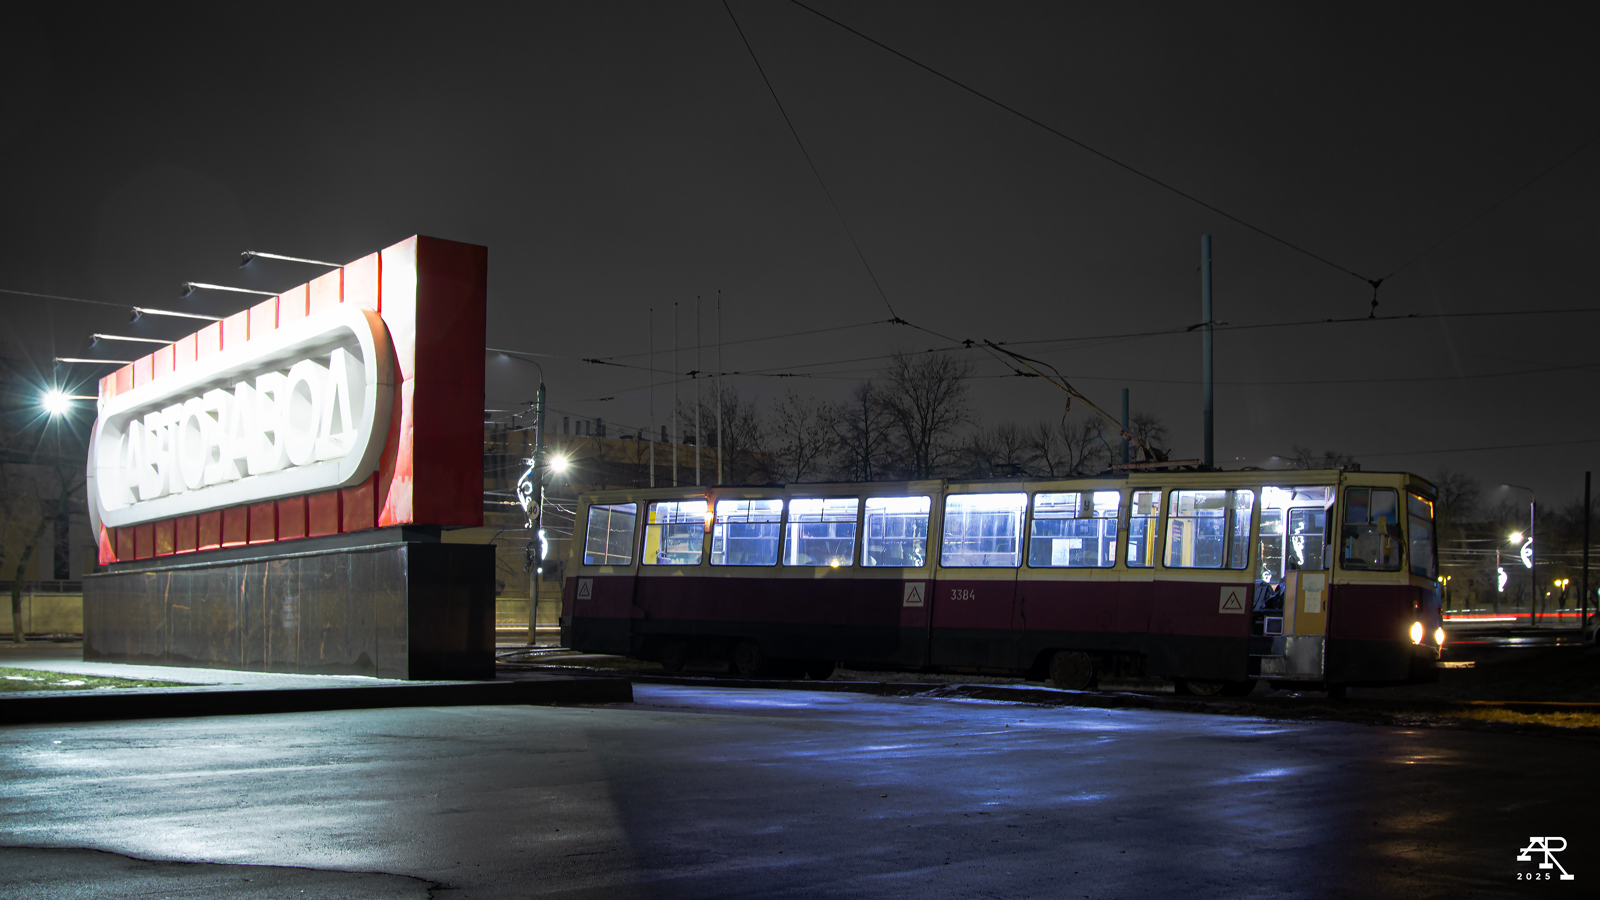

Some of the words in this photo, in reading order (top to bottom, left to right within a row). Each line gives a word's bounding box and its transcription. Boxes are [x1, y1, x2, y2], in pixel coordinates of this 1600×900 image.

[124, 347, 360, 504] АВТОЗАВОД
[528, 506, 537, 514] 40
[951, 589, 975, 600] 3384
